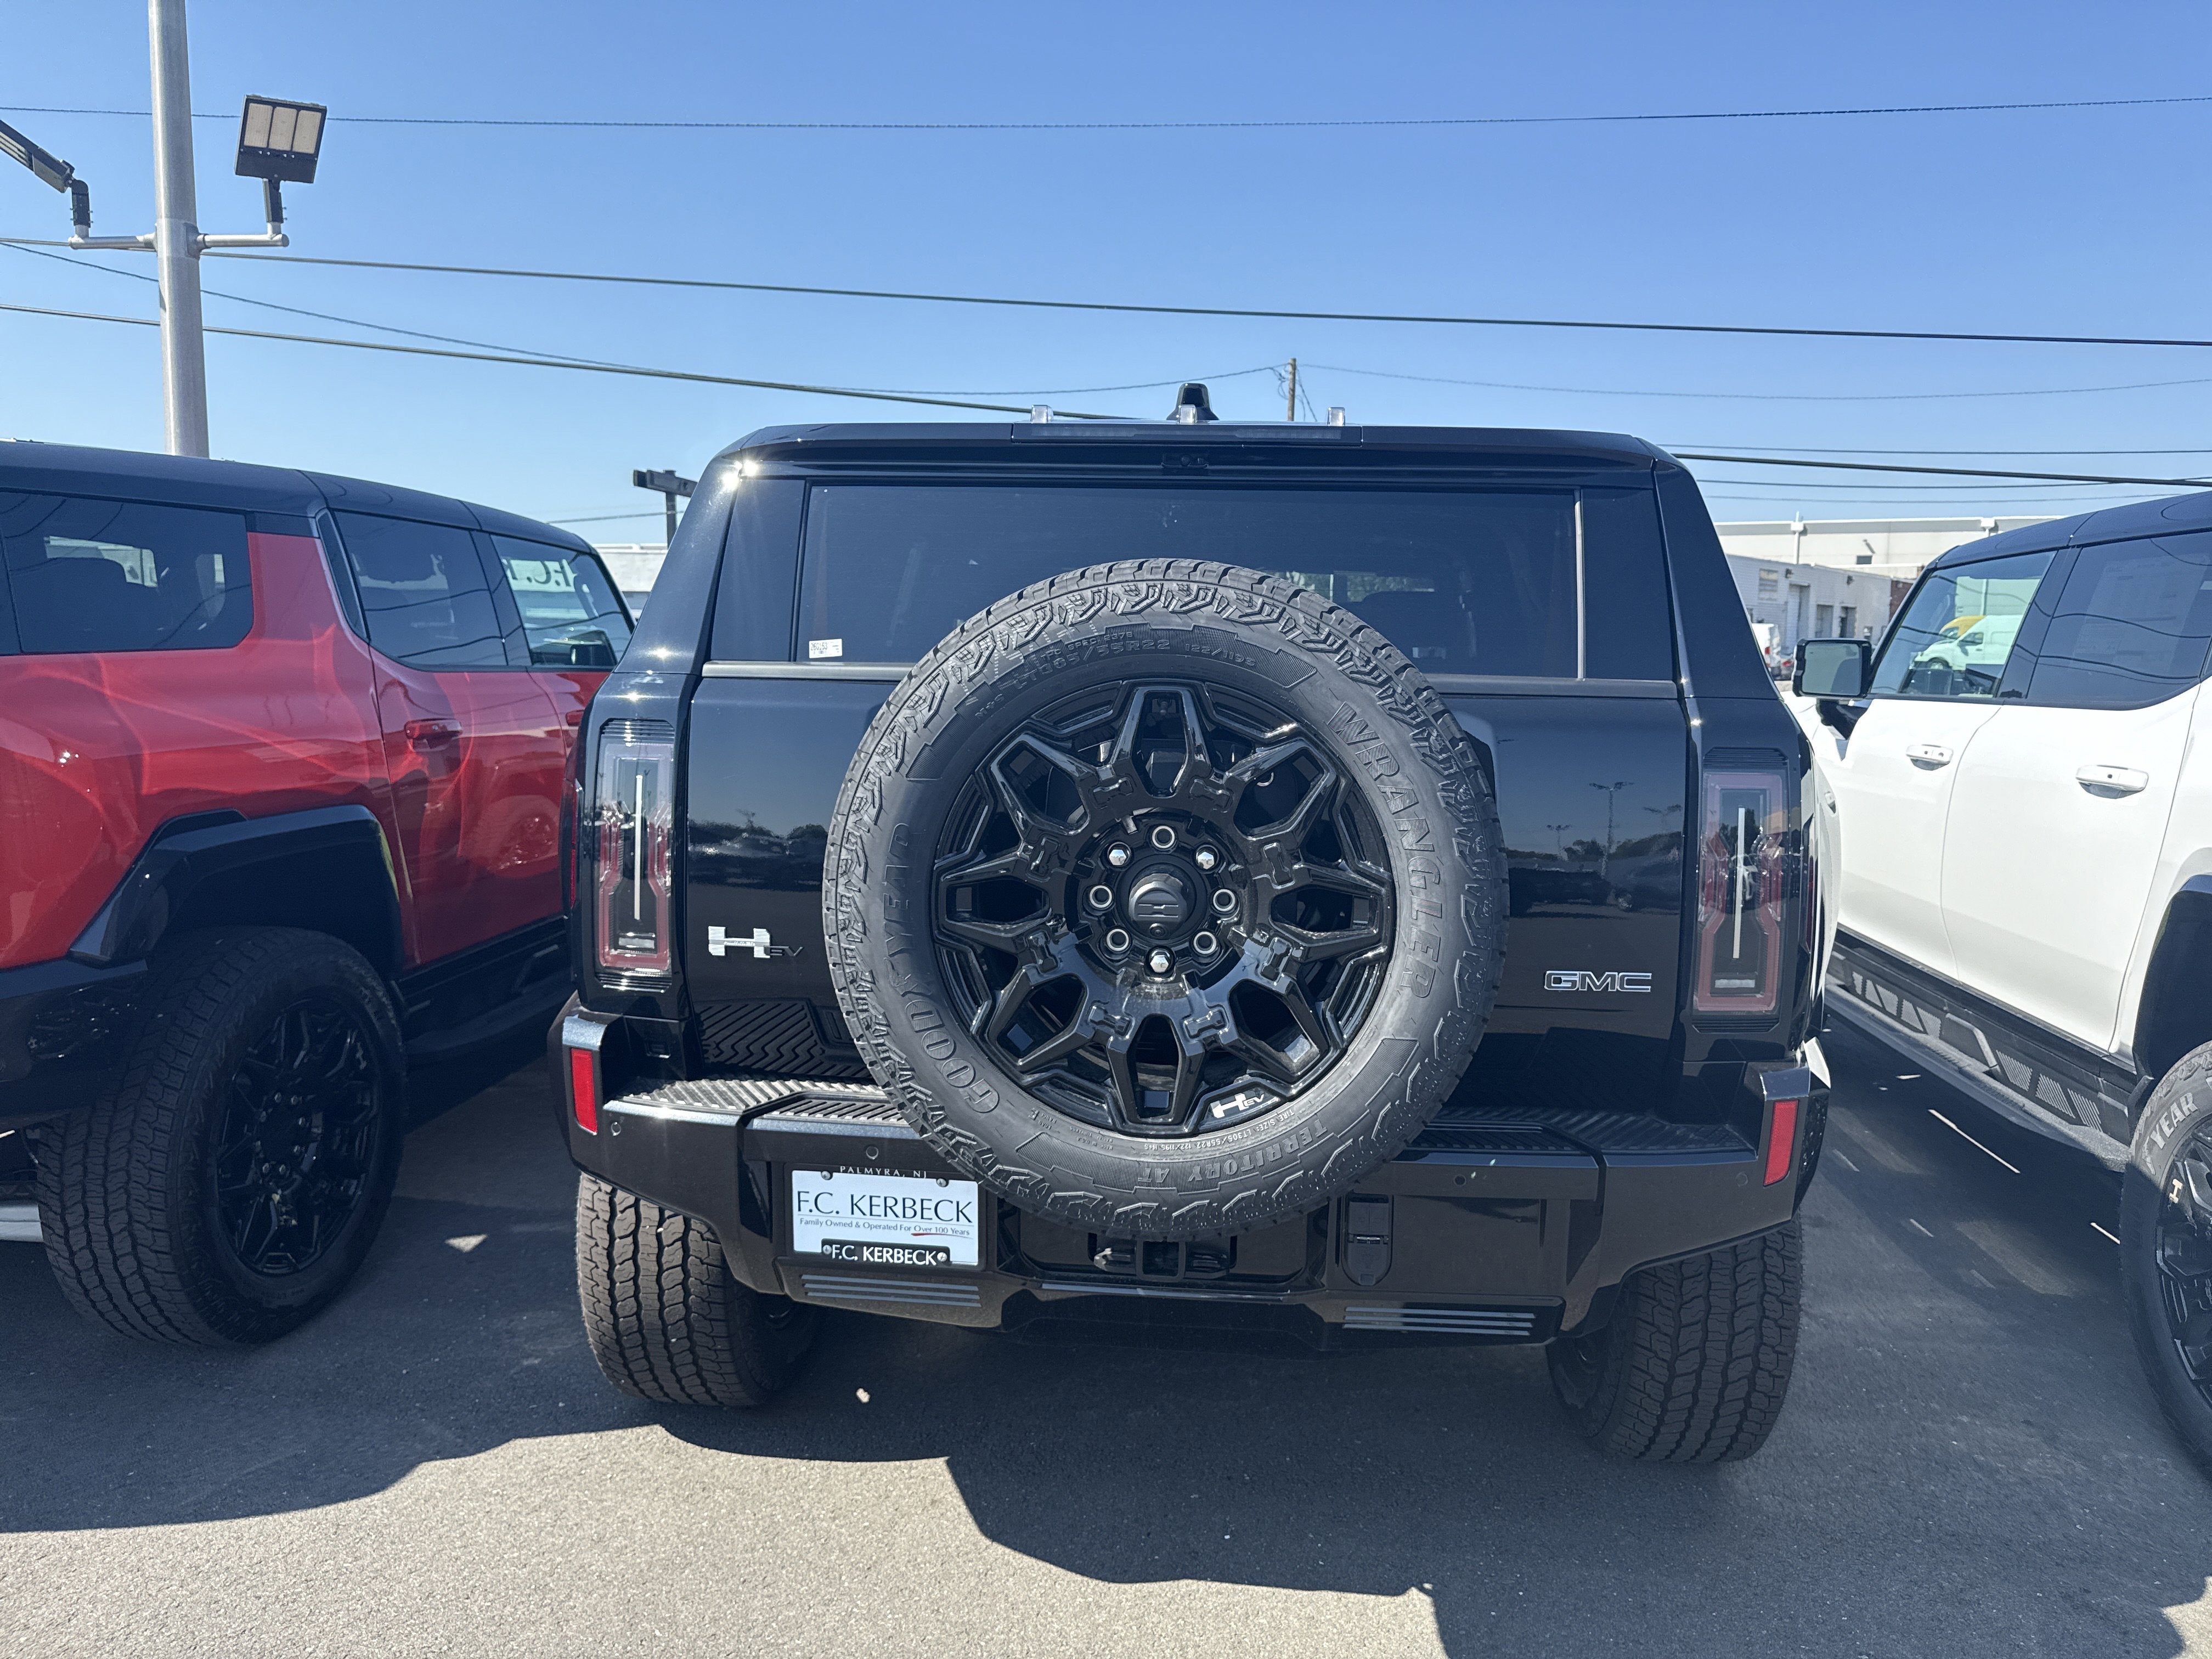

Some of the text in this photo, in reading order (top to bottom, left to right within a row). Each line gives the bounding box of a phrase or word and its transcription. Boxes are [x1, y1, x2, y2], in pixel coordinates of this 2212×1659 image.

[1068, 638, 1097, 650] SPEC
[1327, 701, 1442, 998] WRANGLER
[1544, 970, 1652, 992] GMC
[1256, 1119, 1276, 1132] SIZE:
[1279, 1110, 1295, 1122] TIRE
[1197, 1128, 1252, 1149] LT305/55R22
[1138, 1119, 1328, 1183] TERRITORY AT
[913, 1170, 927, 1178] NJ
[797, 1190, 973, 1223] F.C. KERBECK
[799, 1217, 823, 1227] Family
[825, 1219, 853, 1228] Owned
[863, 1221, 898, 1231] Operated
[950, 1227, 970, 1235] Years
[832, 1244, 936, 1266] F.C. KERBECK
